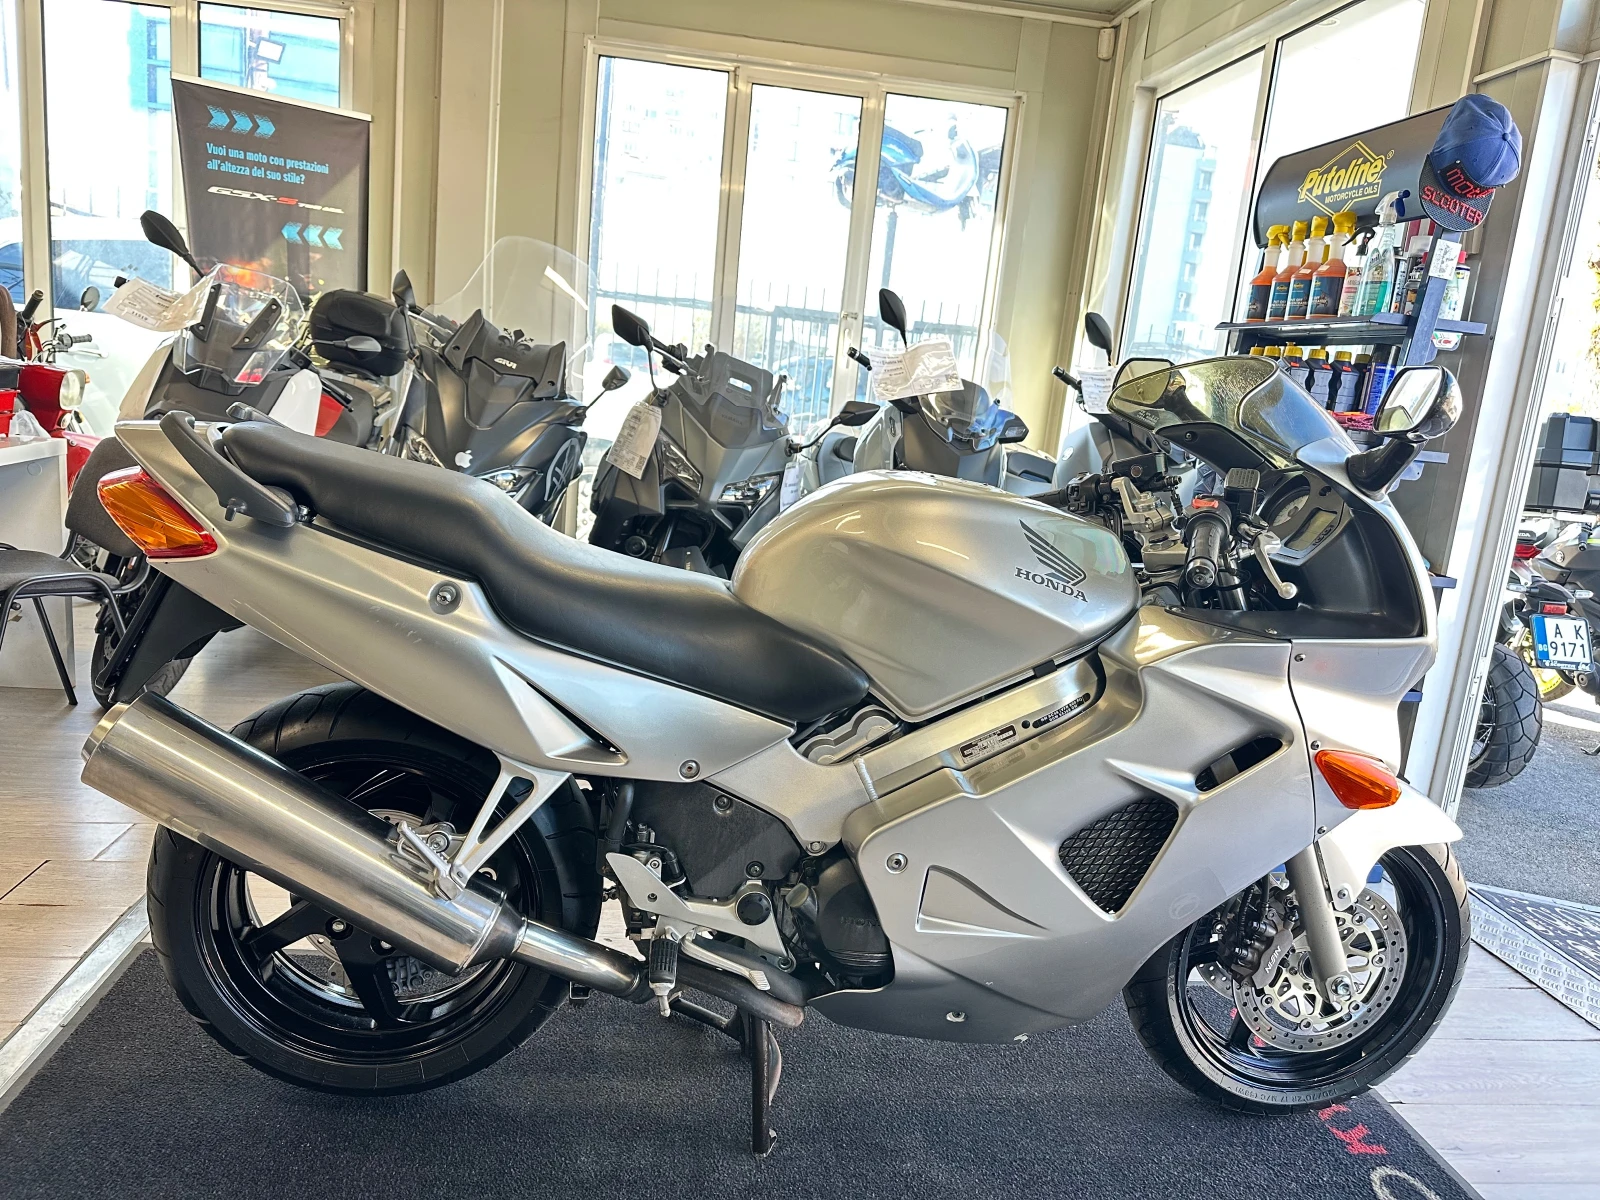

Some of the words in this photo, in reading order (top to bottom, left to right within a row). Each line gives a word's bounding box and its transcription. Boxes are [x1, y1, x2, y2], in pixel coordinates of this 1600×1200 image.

[206, 142, 226, 156] Vuoi
[228, 148, 244, 159] una
[246, 151, 267, 163] moto
[269, 155, 284, 166] con
[286, 158, 329, 174] prestazioni
[206, 159, 250, 175] all'altezza
[251, 166, 265, 178] del
[266, 170, 281, 180] suo
[283, 172, 306, 185] stile?
[1300, 157, 1383, 199] Putoline
[1325, 188, 1363, 203] MOTORCYCLE
[1364, 185, 1378, 195] OILS
[1422, 185, 1483, 225] SCOOTER
[1014, 566, 1089, 603] HONDA
[1554, 623, 1563, 639] A
[1574, 624, 1584, 641] K
[1549, 641, 1586, 659] 9171
